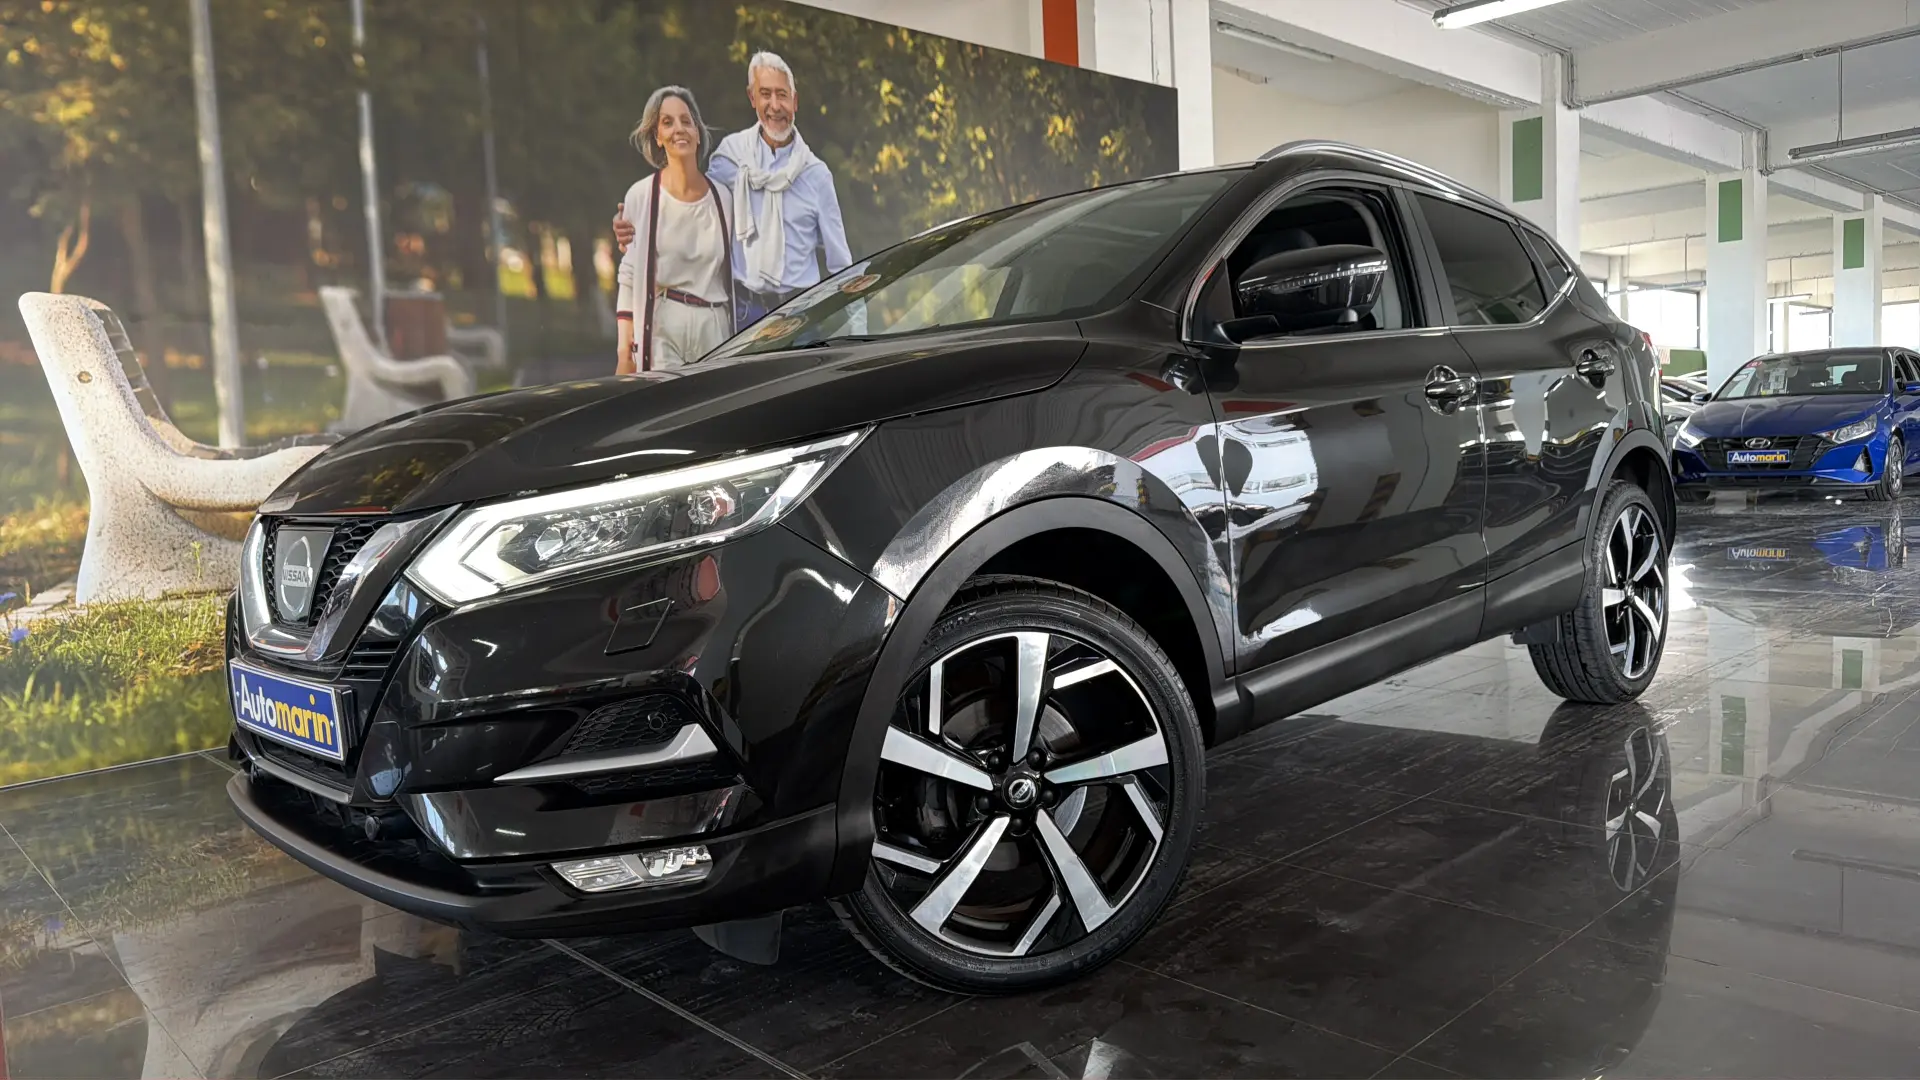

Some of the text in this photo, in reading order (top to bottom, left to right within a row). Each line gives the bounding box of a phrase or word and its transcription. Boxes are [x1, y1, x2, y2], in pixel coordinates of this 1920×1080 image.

[1731, 451, 1786, 462] Automarin
[282, 567, 310, 584] NISSAN
[241, 673, 333, 746] Automarin
